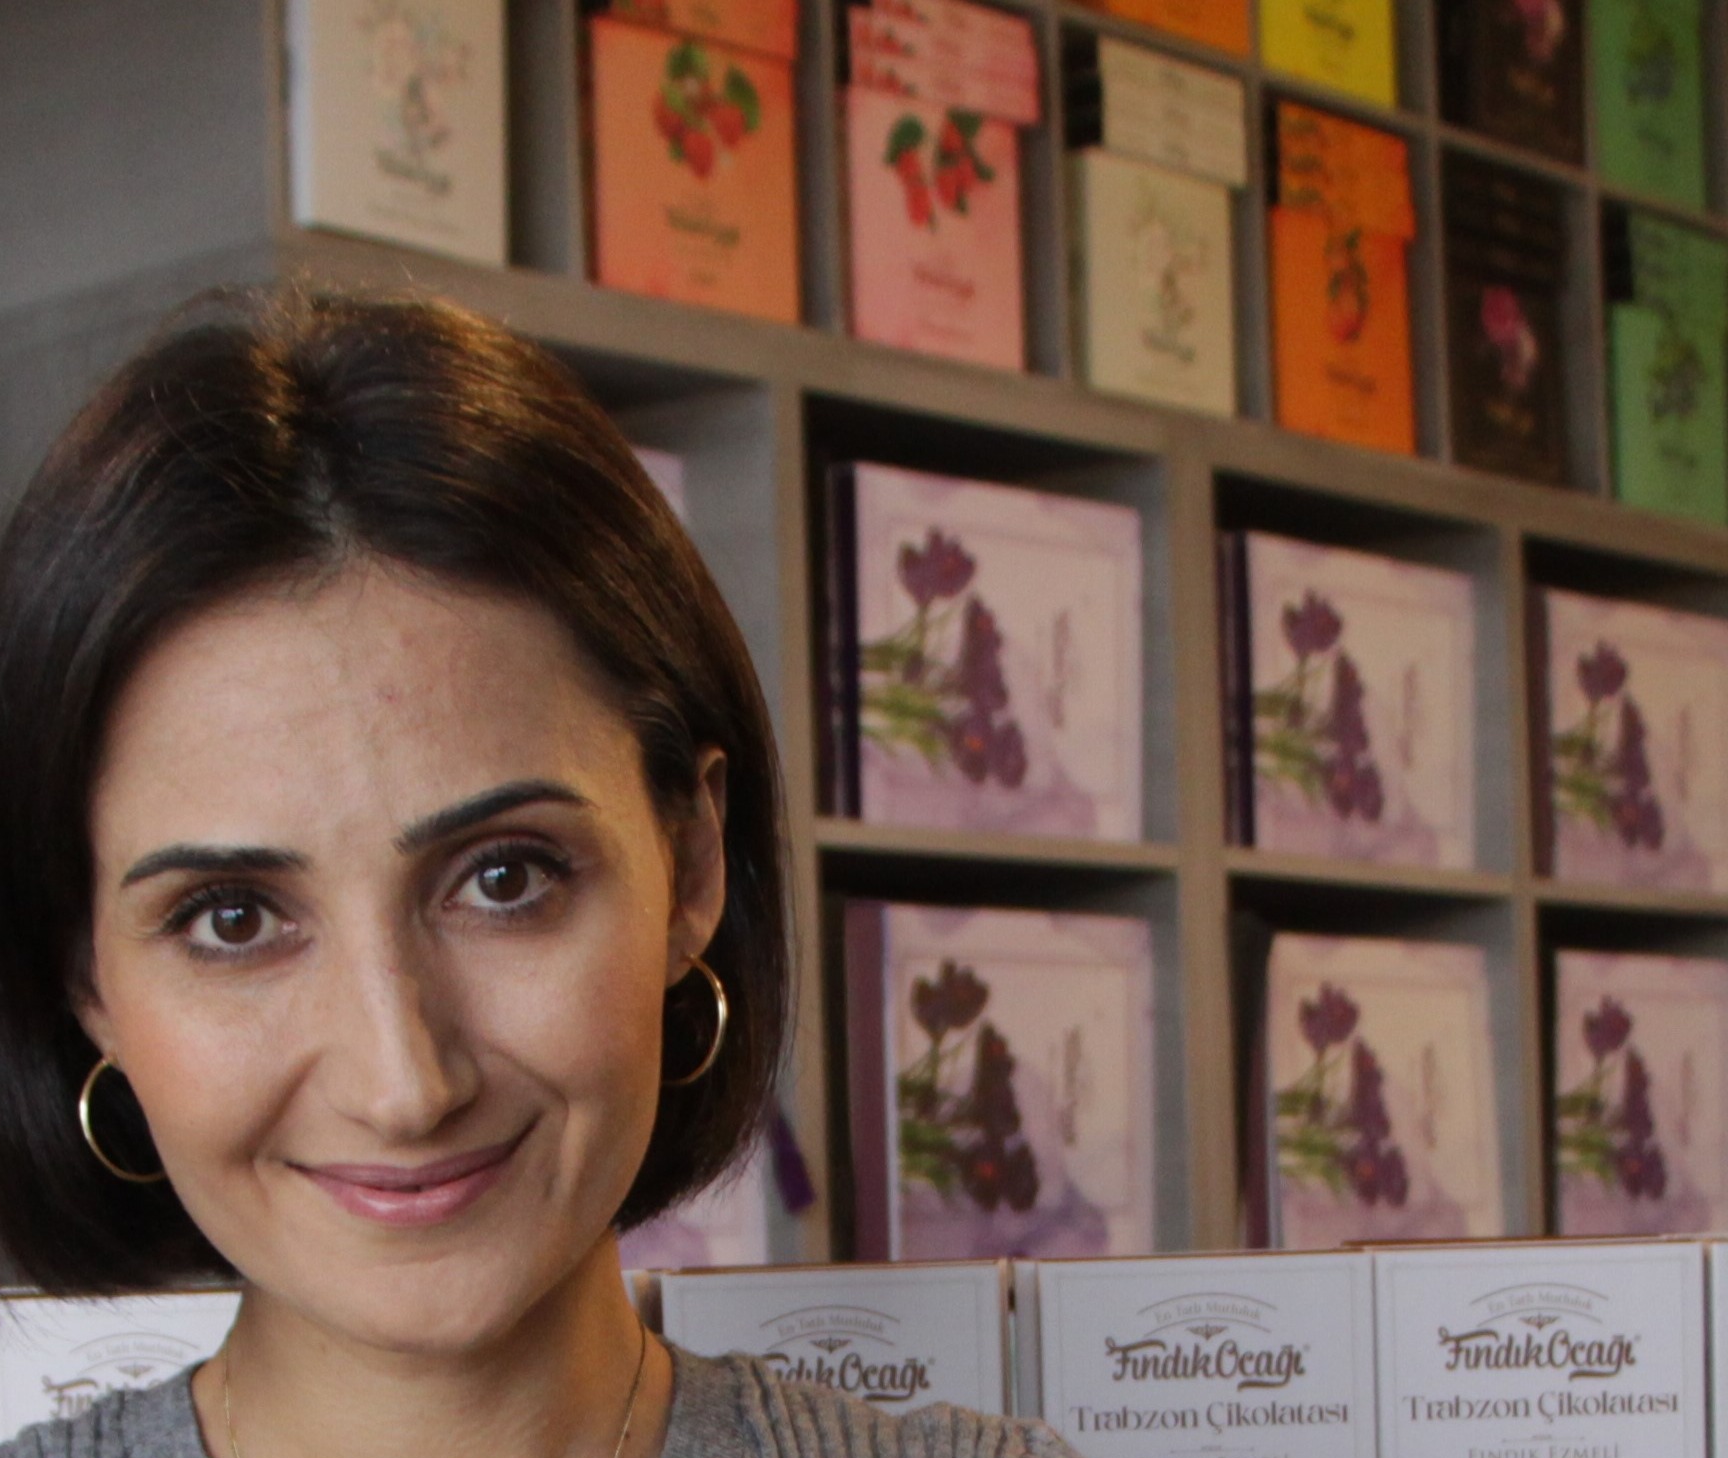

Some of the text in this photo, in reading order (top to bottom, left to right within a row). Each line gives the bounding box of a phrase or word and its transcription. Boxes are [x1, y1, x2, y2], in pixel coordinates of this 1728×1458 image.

[1154, 1311, 1171, 1324] En
[1070, 1401, 1349, 1435] Trabzon Çikolatası
[1402, 1391, 1679, 1424] Trabzon Çikolatası
